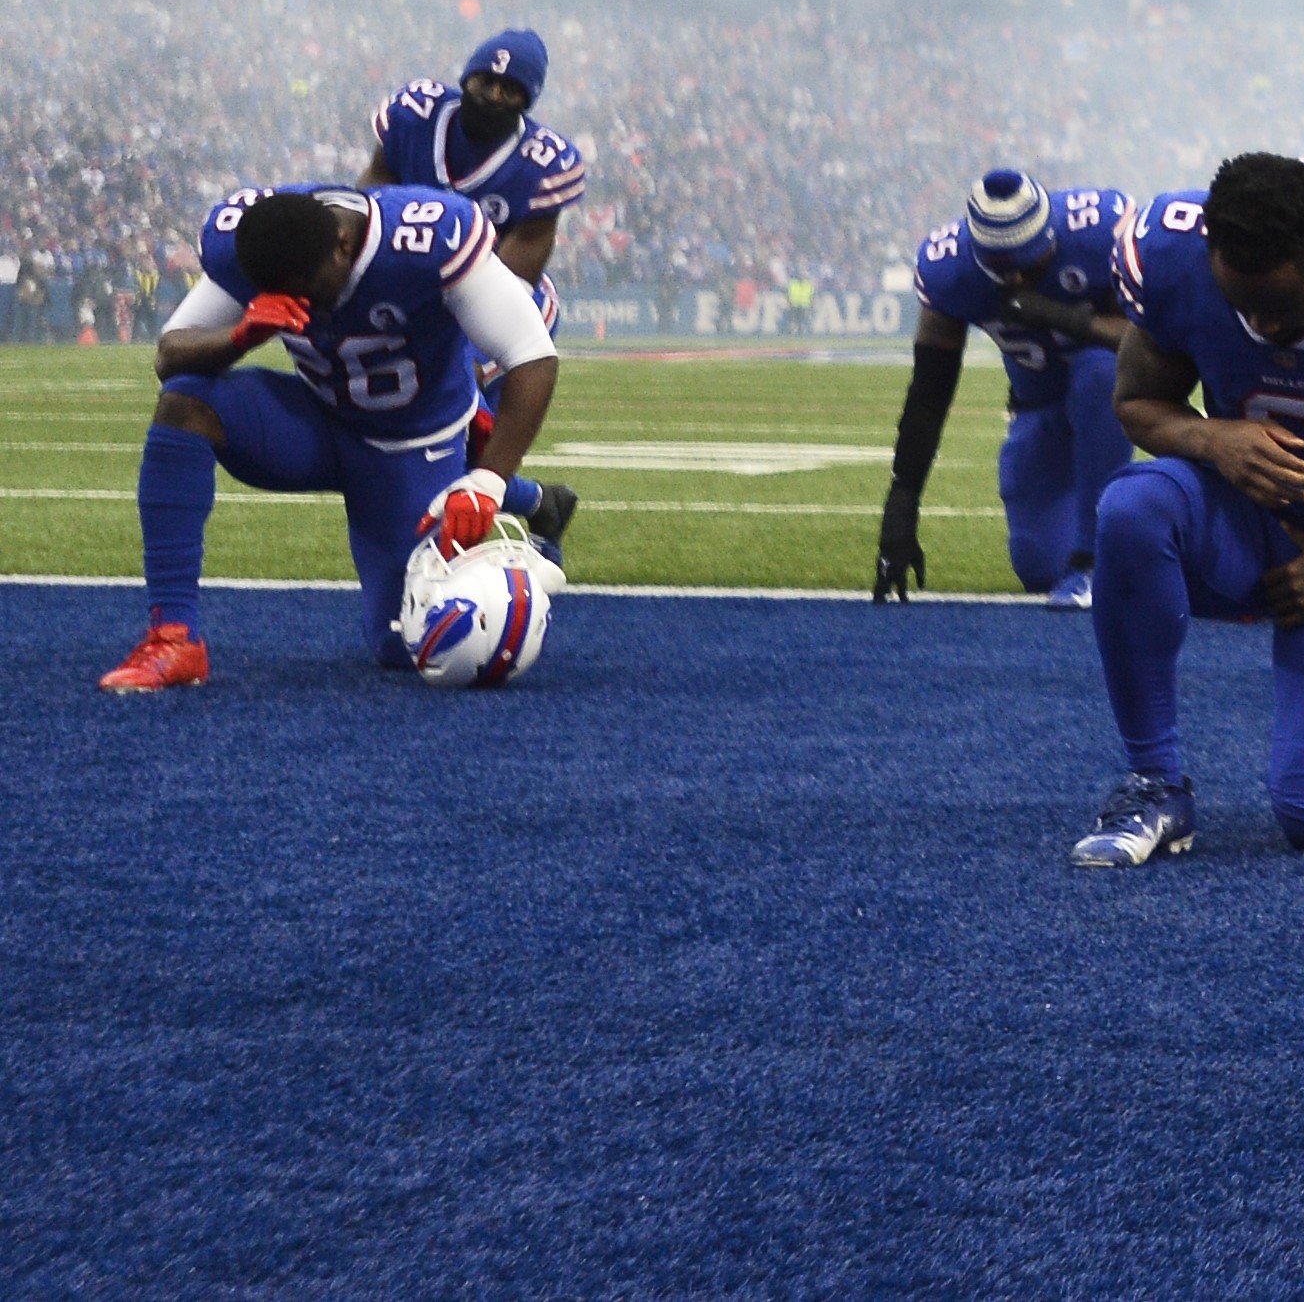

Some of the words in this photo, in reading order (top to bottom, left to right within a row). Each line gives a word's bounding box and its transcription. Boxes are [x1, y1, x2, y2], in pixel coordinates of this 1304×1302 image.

[401, 78, 445, 120] 27
[521, 127, 567, 169] 27
[391, 200, 446, 254] 26
[1066, 190, 1100, 232] 55
